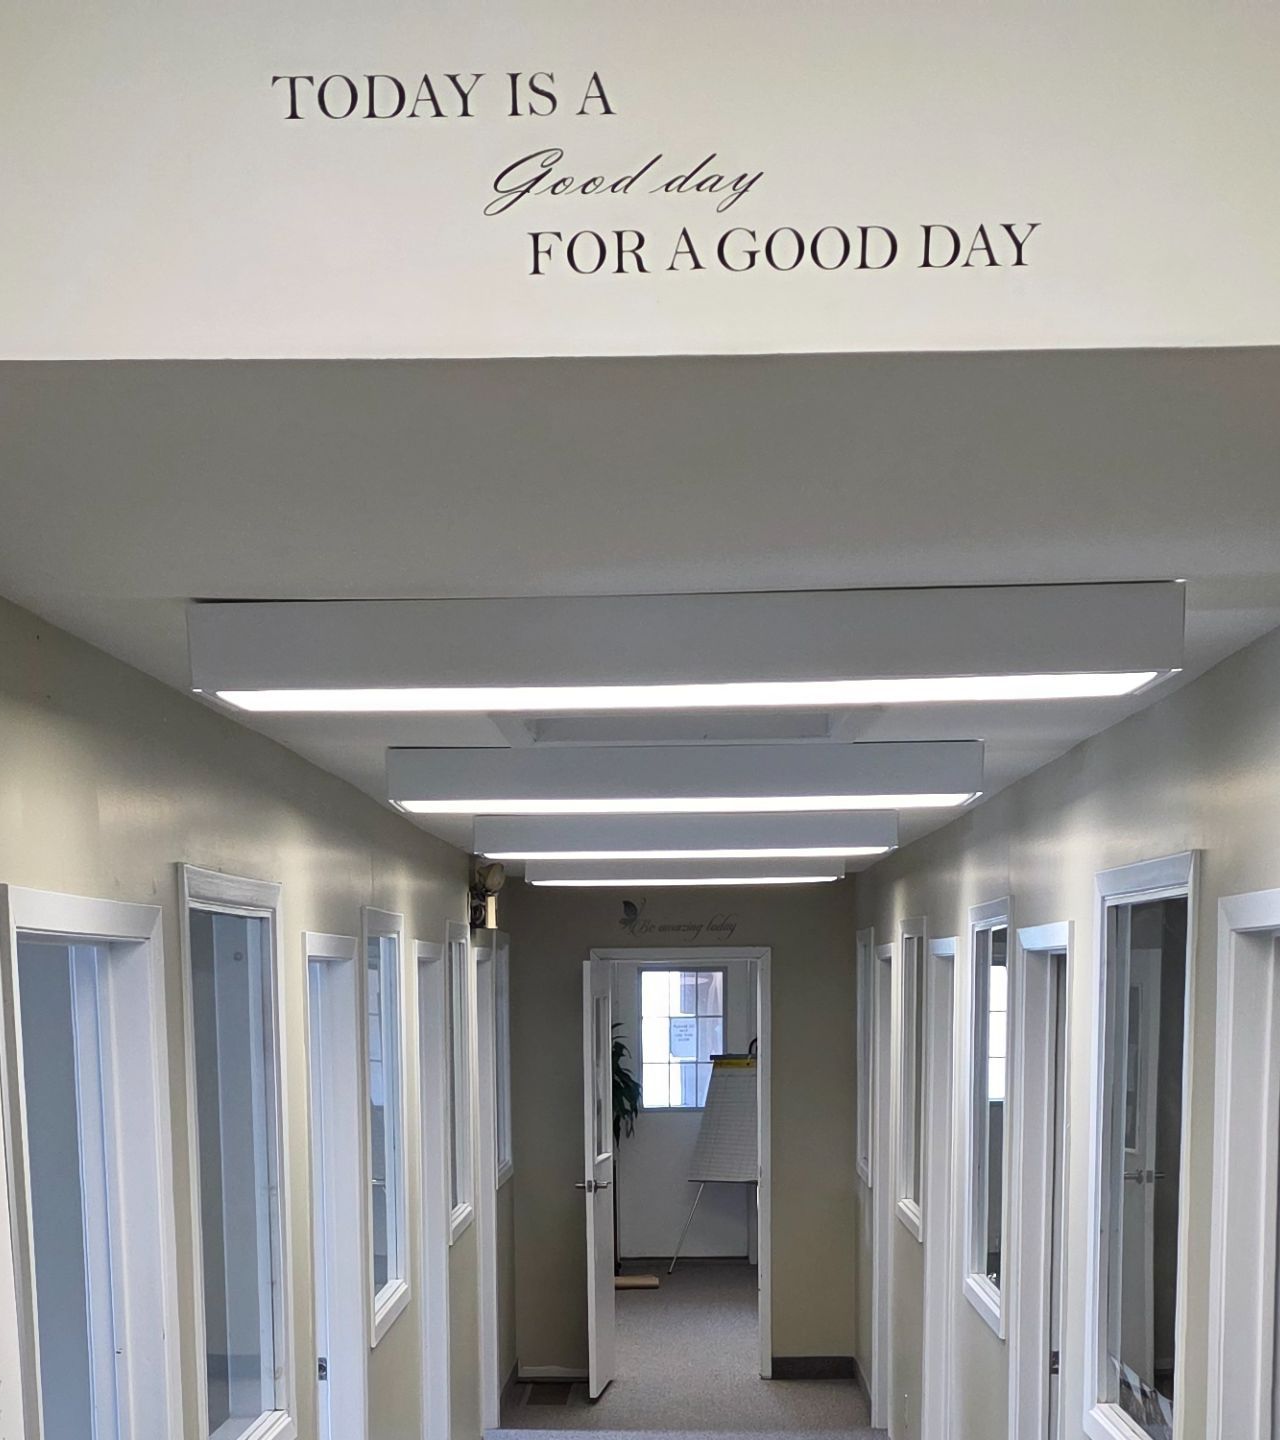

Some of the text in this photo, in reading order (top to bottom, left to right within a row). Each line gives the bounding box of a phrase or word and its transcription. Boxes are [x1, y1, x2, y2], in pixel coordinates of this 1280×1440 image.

[272, 71, 616, 120] TODAY IS A
[483, 146, 765, 217] Good day
[527, 222, 1041, 276] FOR A GOOD DAY
